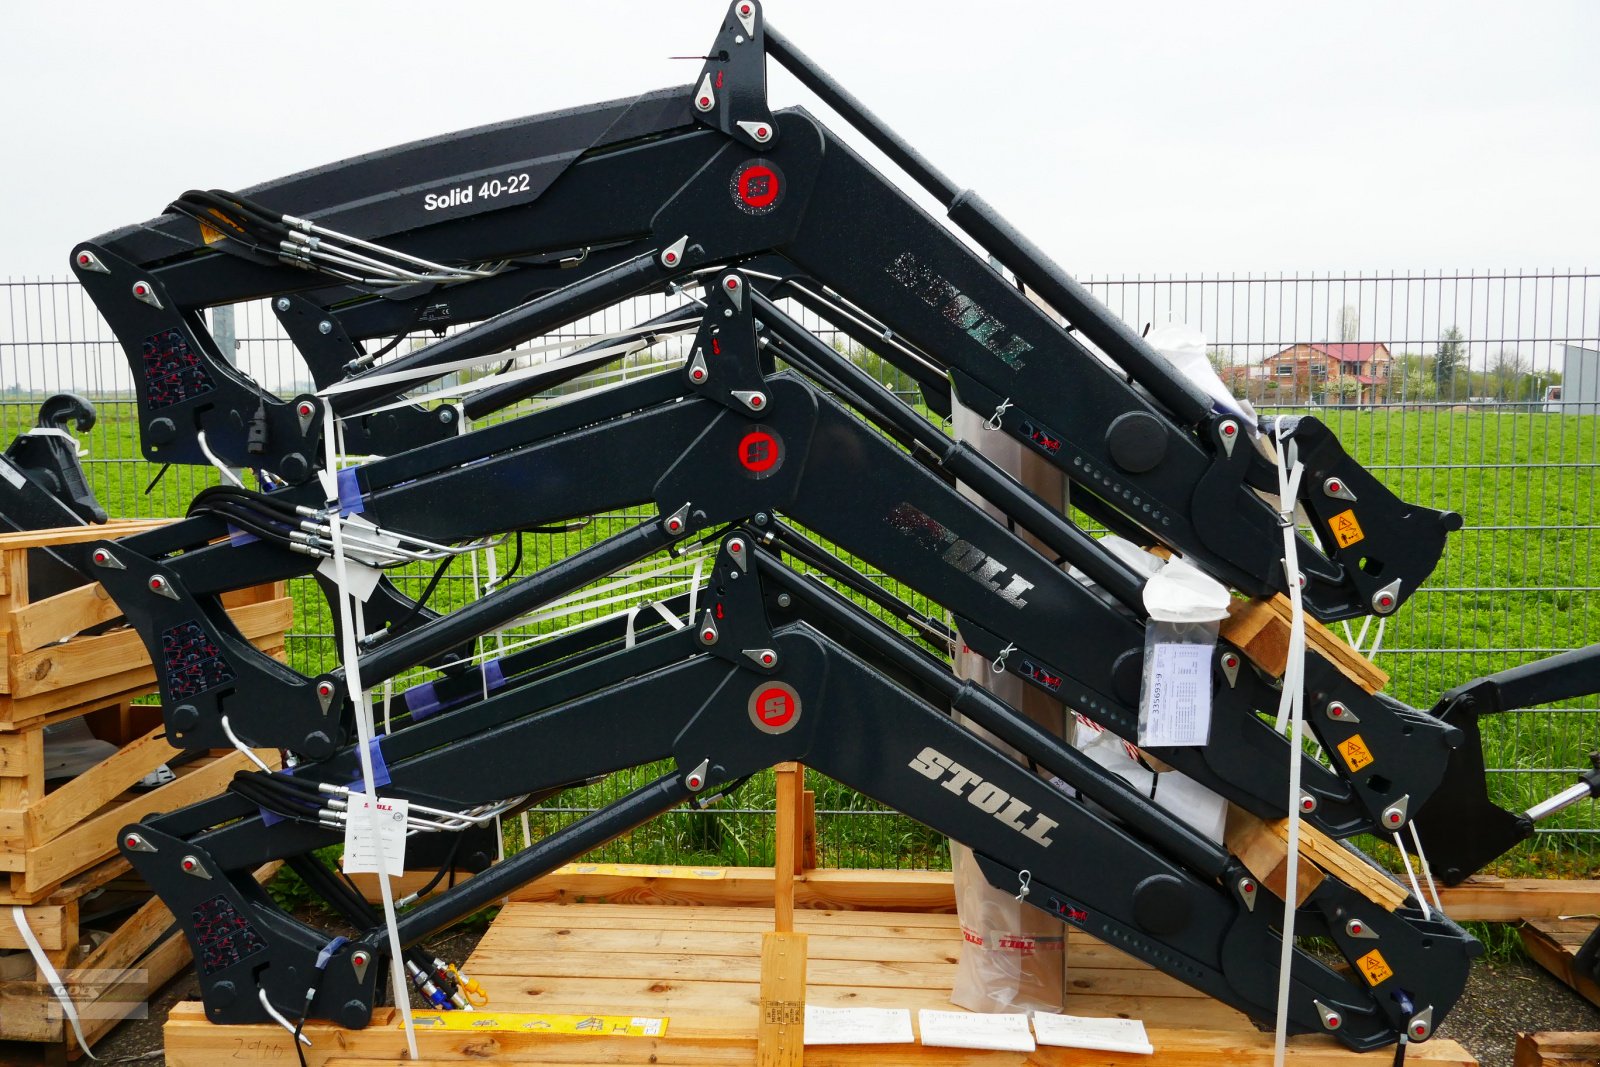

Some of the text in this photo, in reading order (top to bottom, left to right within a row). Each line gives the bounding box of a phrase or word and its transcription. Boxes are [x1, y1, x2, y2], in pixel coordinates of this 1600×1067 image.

[424, 173, 530, 211] Solid 40-22
[1152, 673, 1163, 715] 335693-9
[364, 802, 393, 811] SOLL
[907, 746, 1060, 848] STOLL
